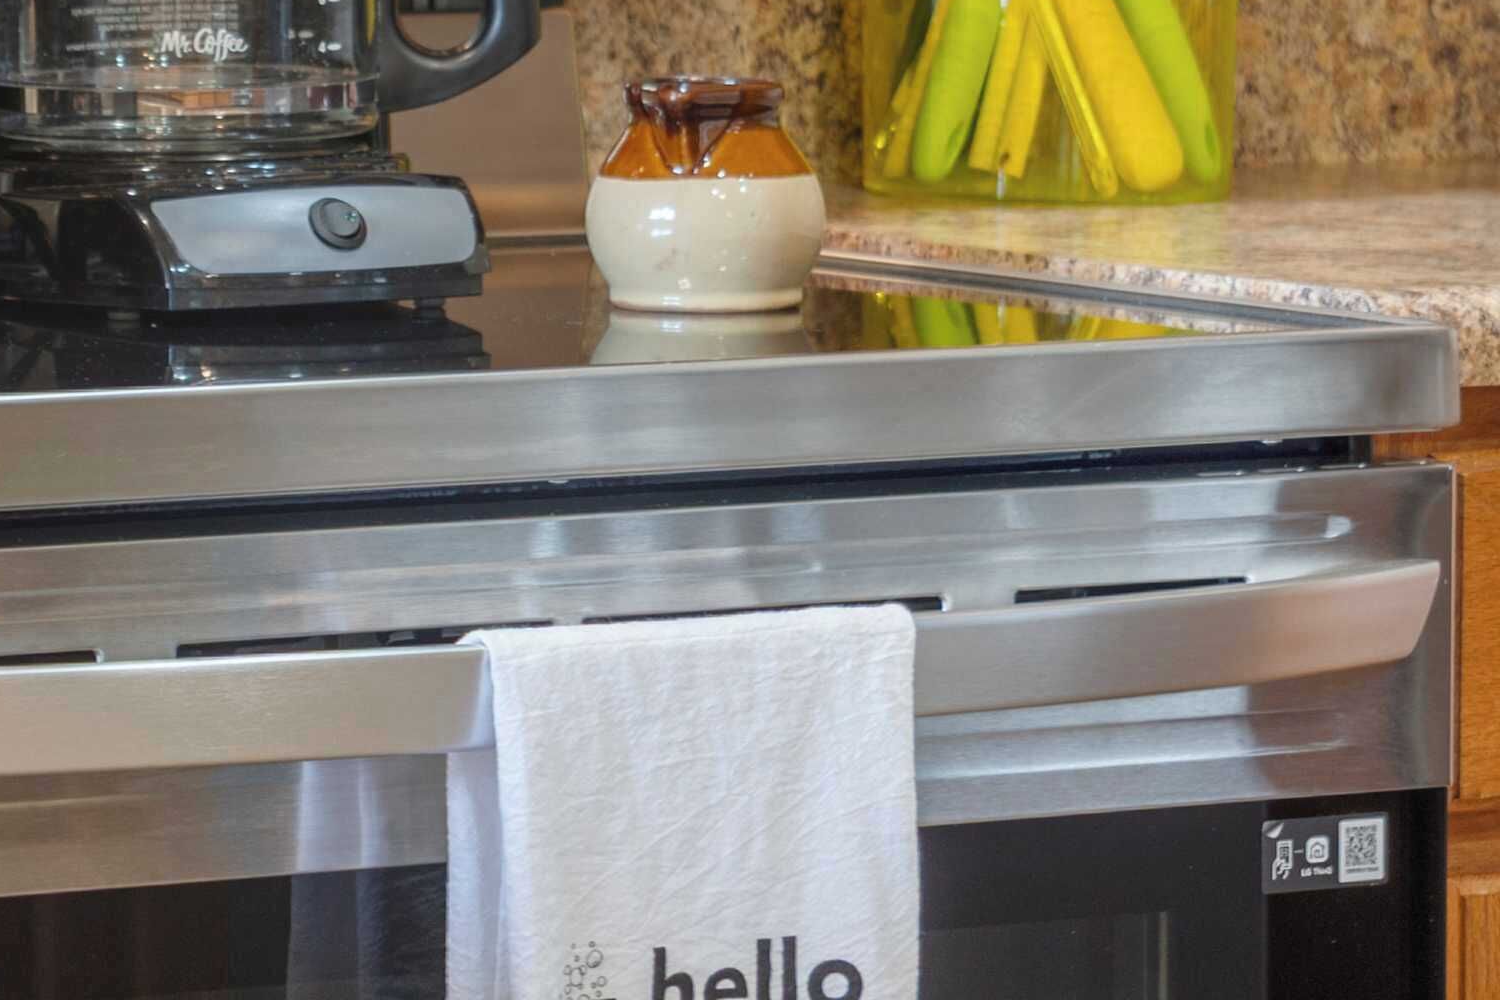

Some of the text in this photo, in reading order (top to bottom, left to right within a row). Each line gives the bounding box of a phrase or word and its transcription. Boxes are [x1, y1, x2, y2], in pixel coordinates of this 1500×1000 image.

[160, 30, 192, 59] Mr.
[193, 27, 249, 62] Coffee
[1300, 866, 1312, 877] LG
[652, 935, 864, 1000] hello
